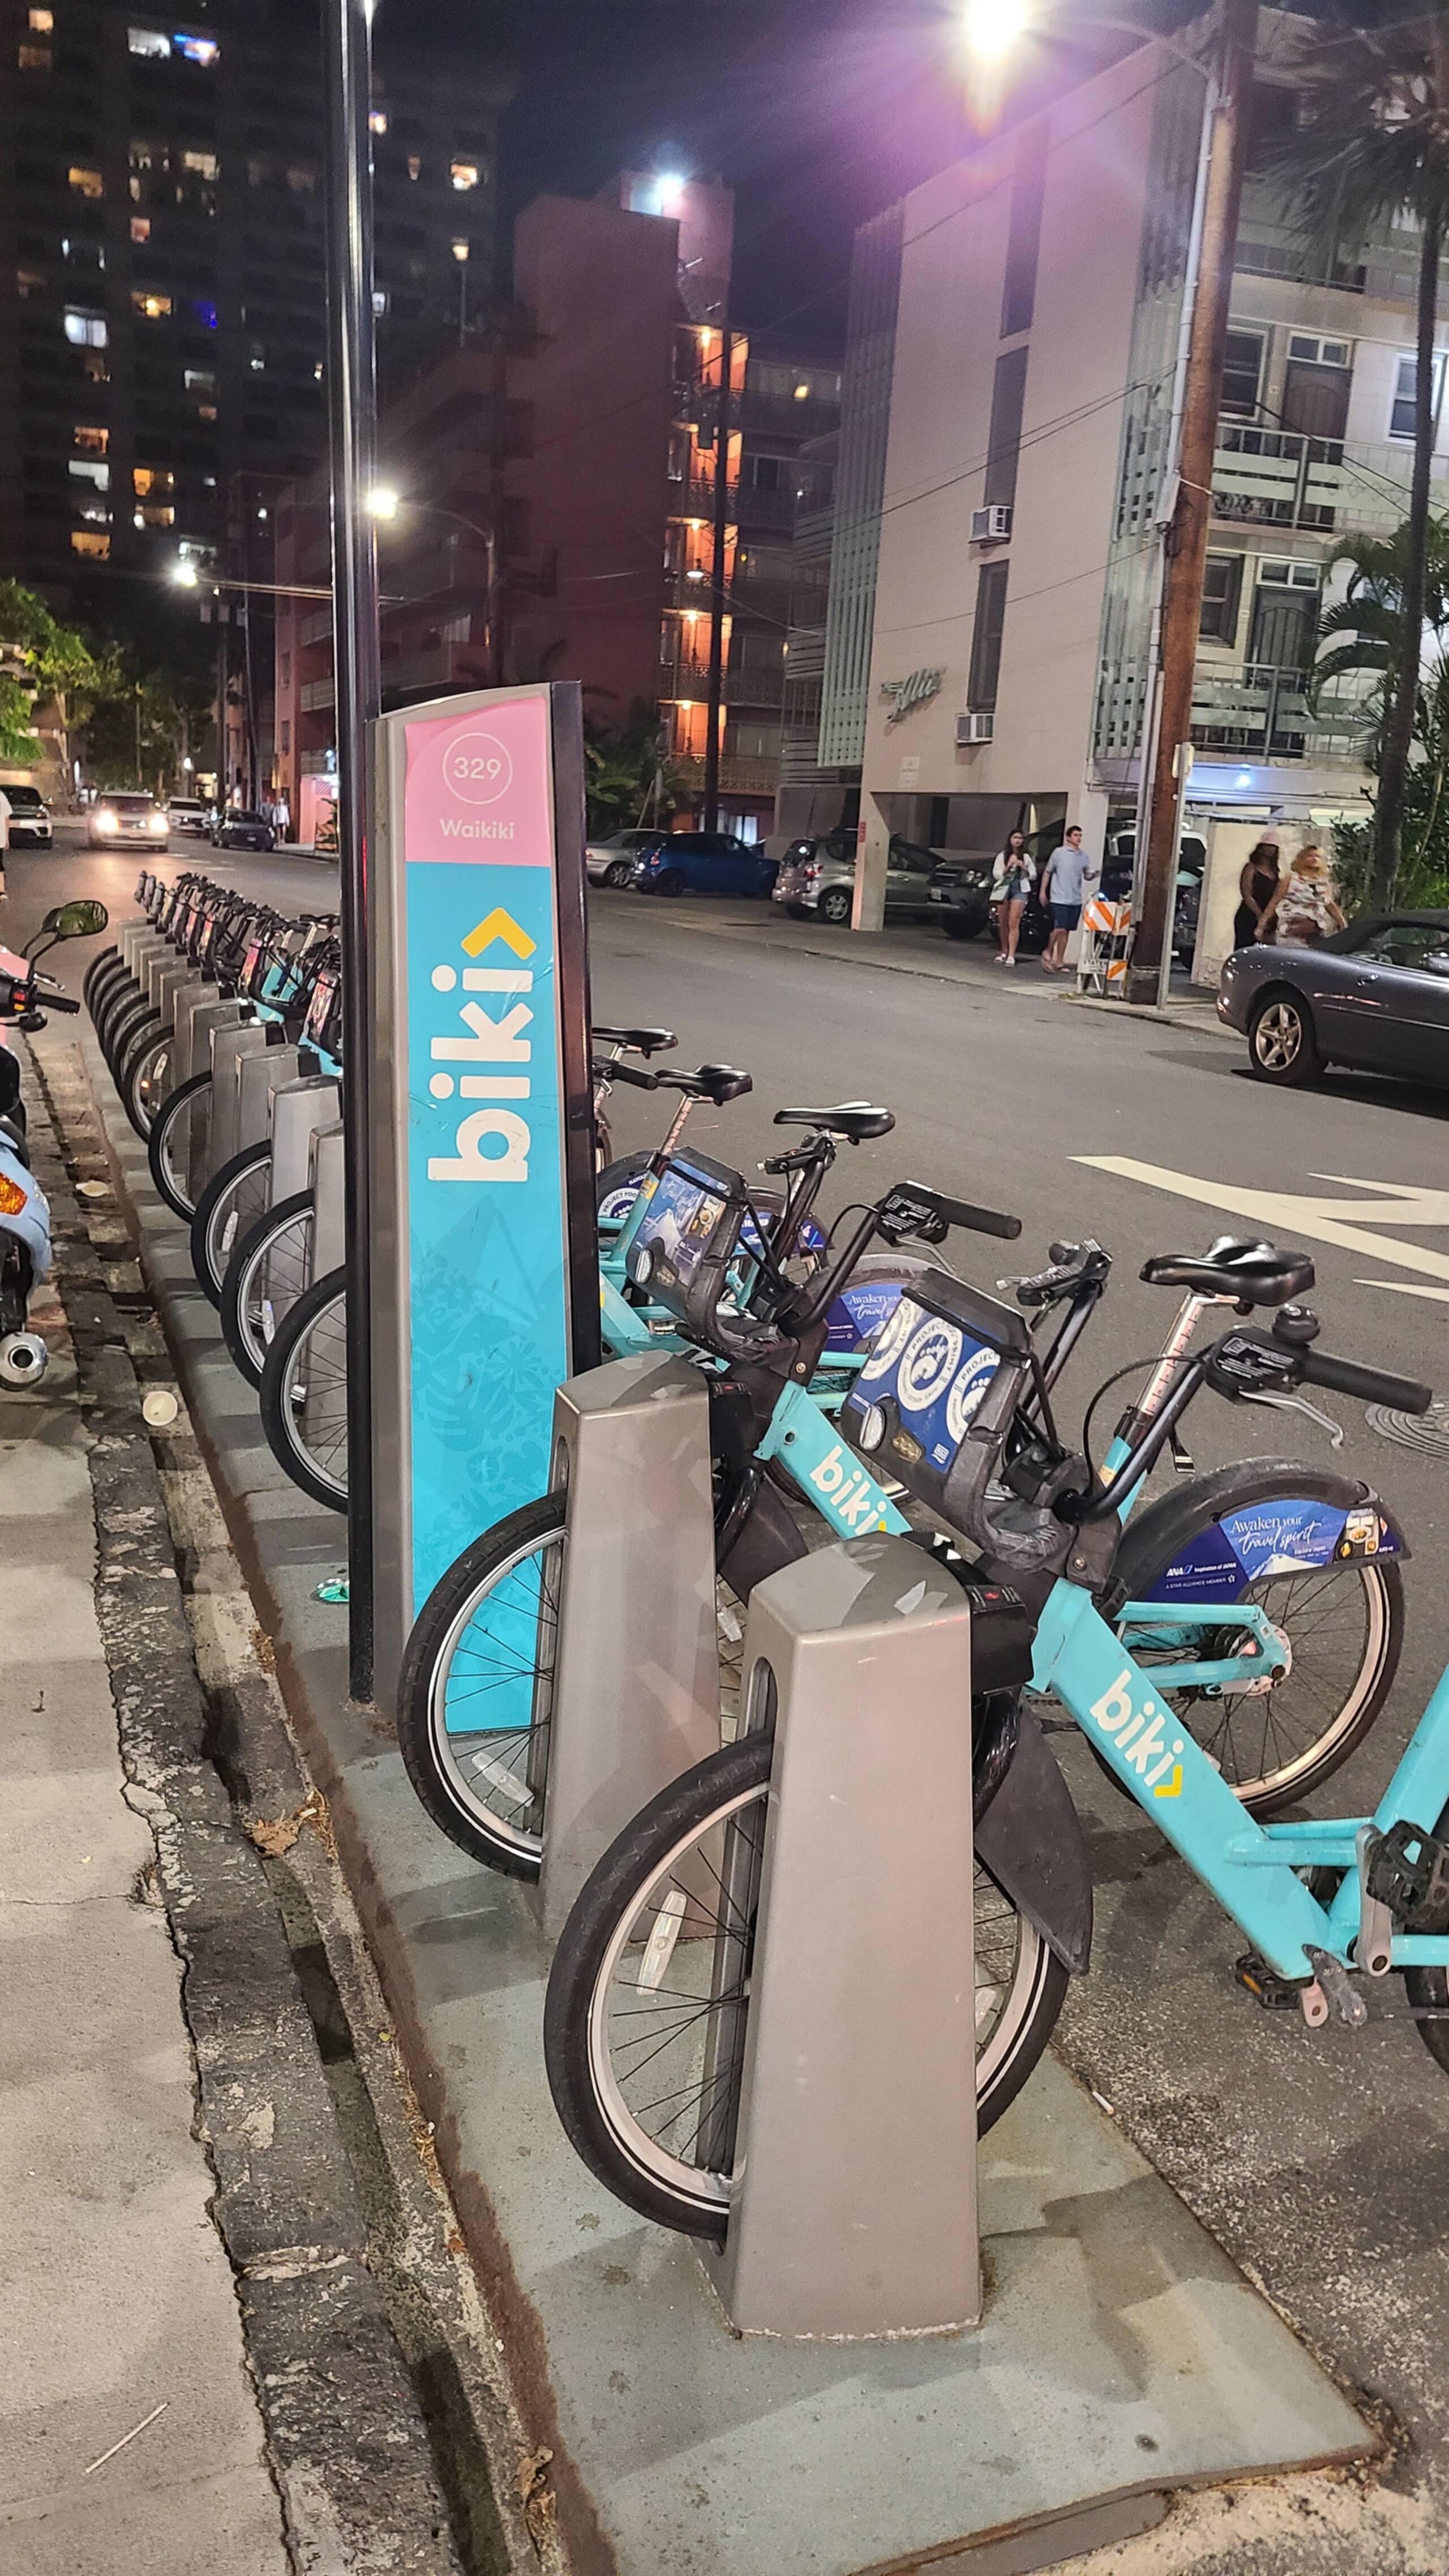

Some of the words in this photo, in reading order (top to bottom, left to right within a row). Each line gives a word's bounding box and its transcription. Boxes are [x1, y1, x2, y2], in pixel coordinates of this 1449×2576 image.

[454, 757, 502, 779] 329
[439, 818, 515, 839] Waikiki
[427, 965, 534, 1182] biki
[603, 1192, 623, 1212] PROJECT
[850, 1293, 886, 1305] Awaken
[855, 1302, 887, 1320] travel
[809, 1445, 887, 1536] biki
[1231, 1516, 1280, 1533] Awaken
[1283, 1516, 1302, 1529] your
[1238, 1527, 1281, 1555] travel
[1279, 1520, 1322, 1551] spirit
[1166, 1567, 1183, 1576] ANA
[1089, 1668, 1185, 1788] biki
